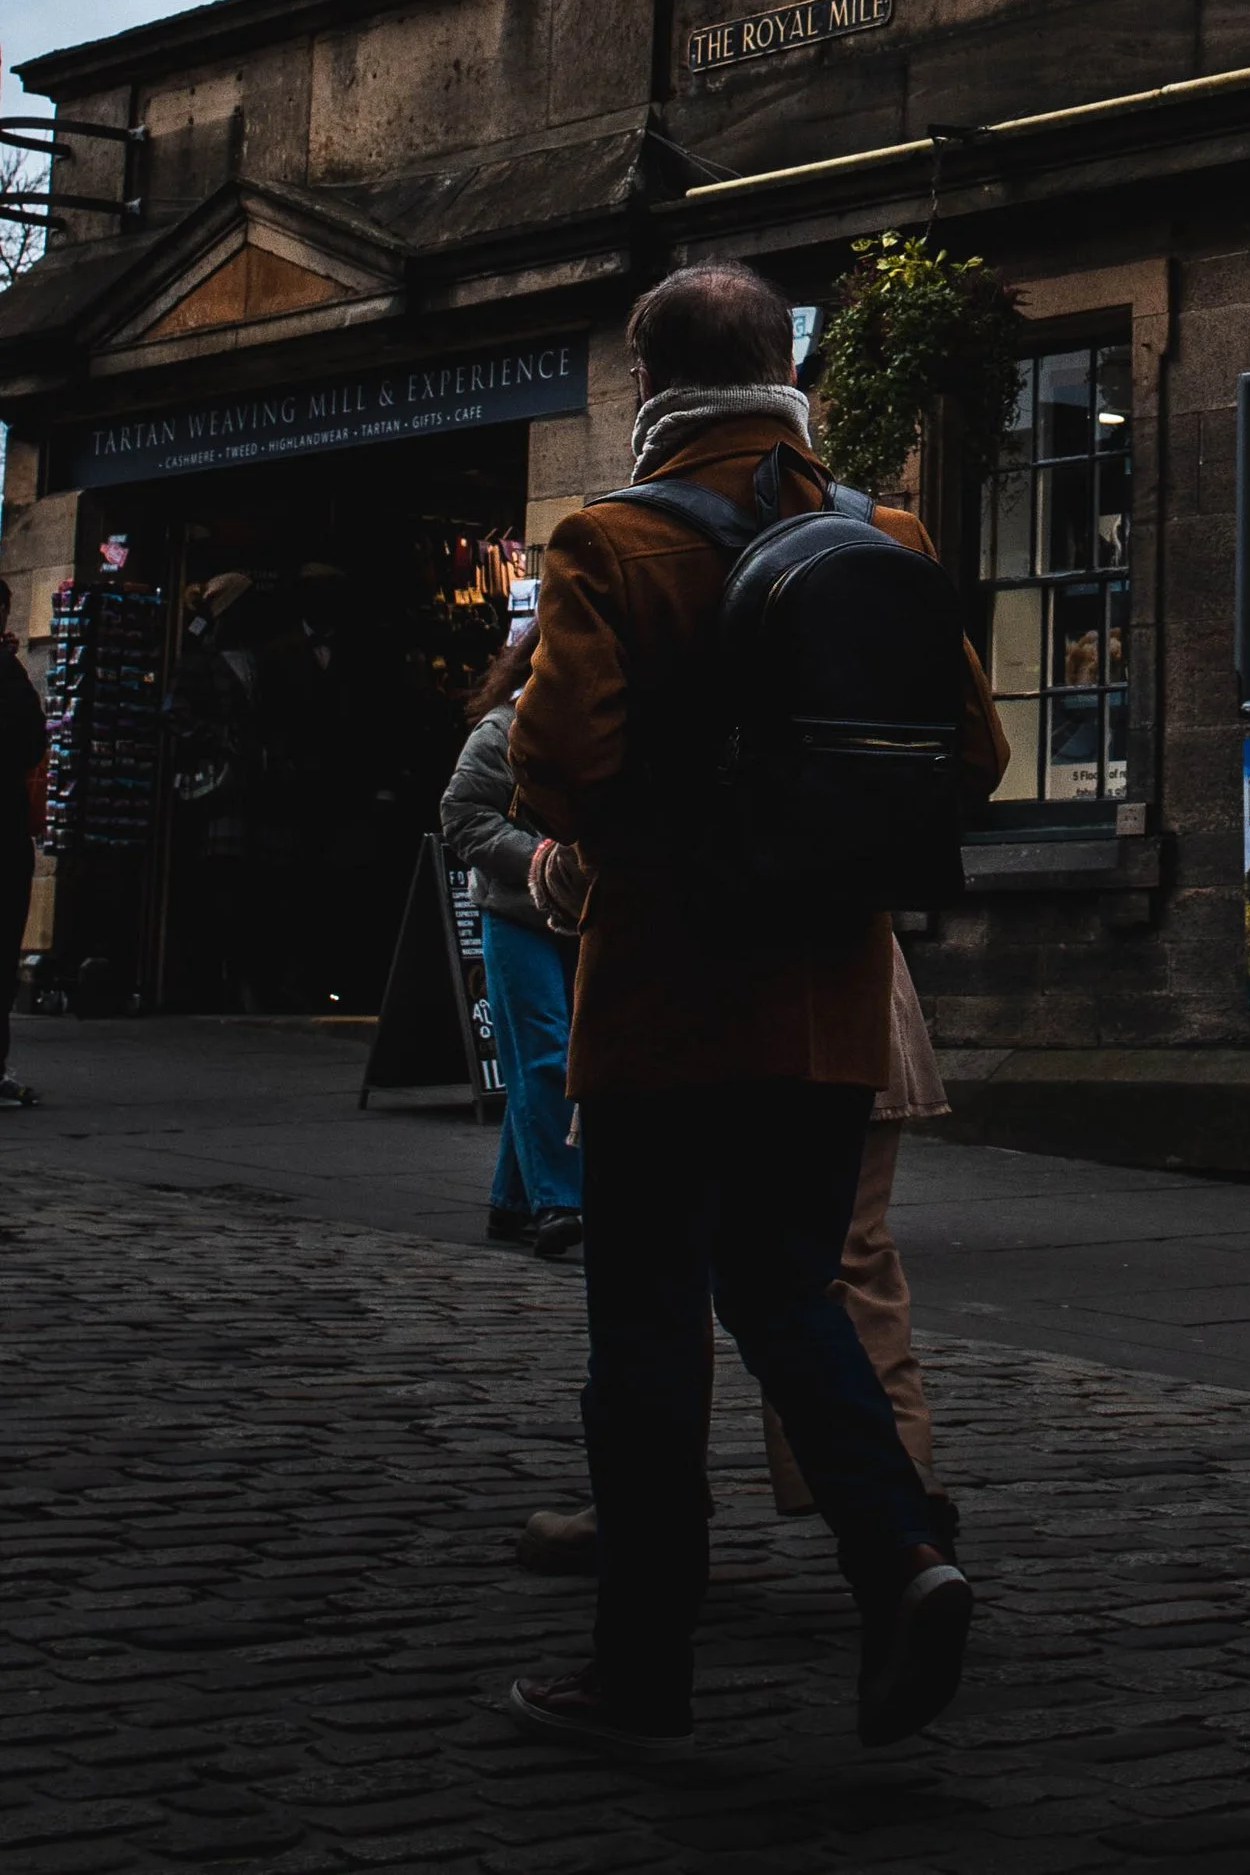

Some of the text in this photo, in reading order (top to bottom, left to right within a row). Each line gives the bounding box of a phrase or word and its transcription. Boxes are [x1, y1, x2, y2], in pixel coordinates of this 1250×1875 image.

[694, 28, 735, 64] THE
[742, 7, 819, 52] ROYAL
[93, 347, 570, 456] TARTAN WEAVING MILL & EXPERIENCE
[165, 450, 215, 470] CASHMERE
[225, 442, 258, 459] TWEED
[268, 426, 349, 452] HIGHLANDWEAR
[361, 417, 401, 437] TARTAN
[411, 412, 443, 429] GIFTS
